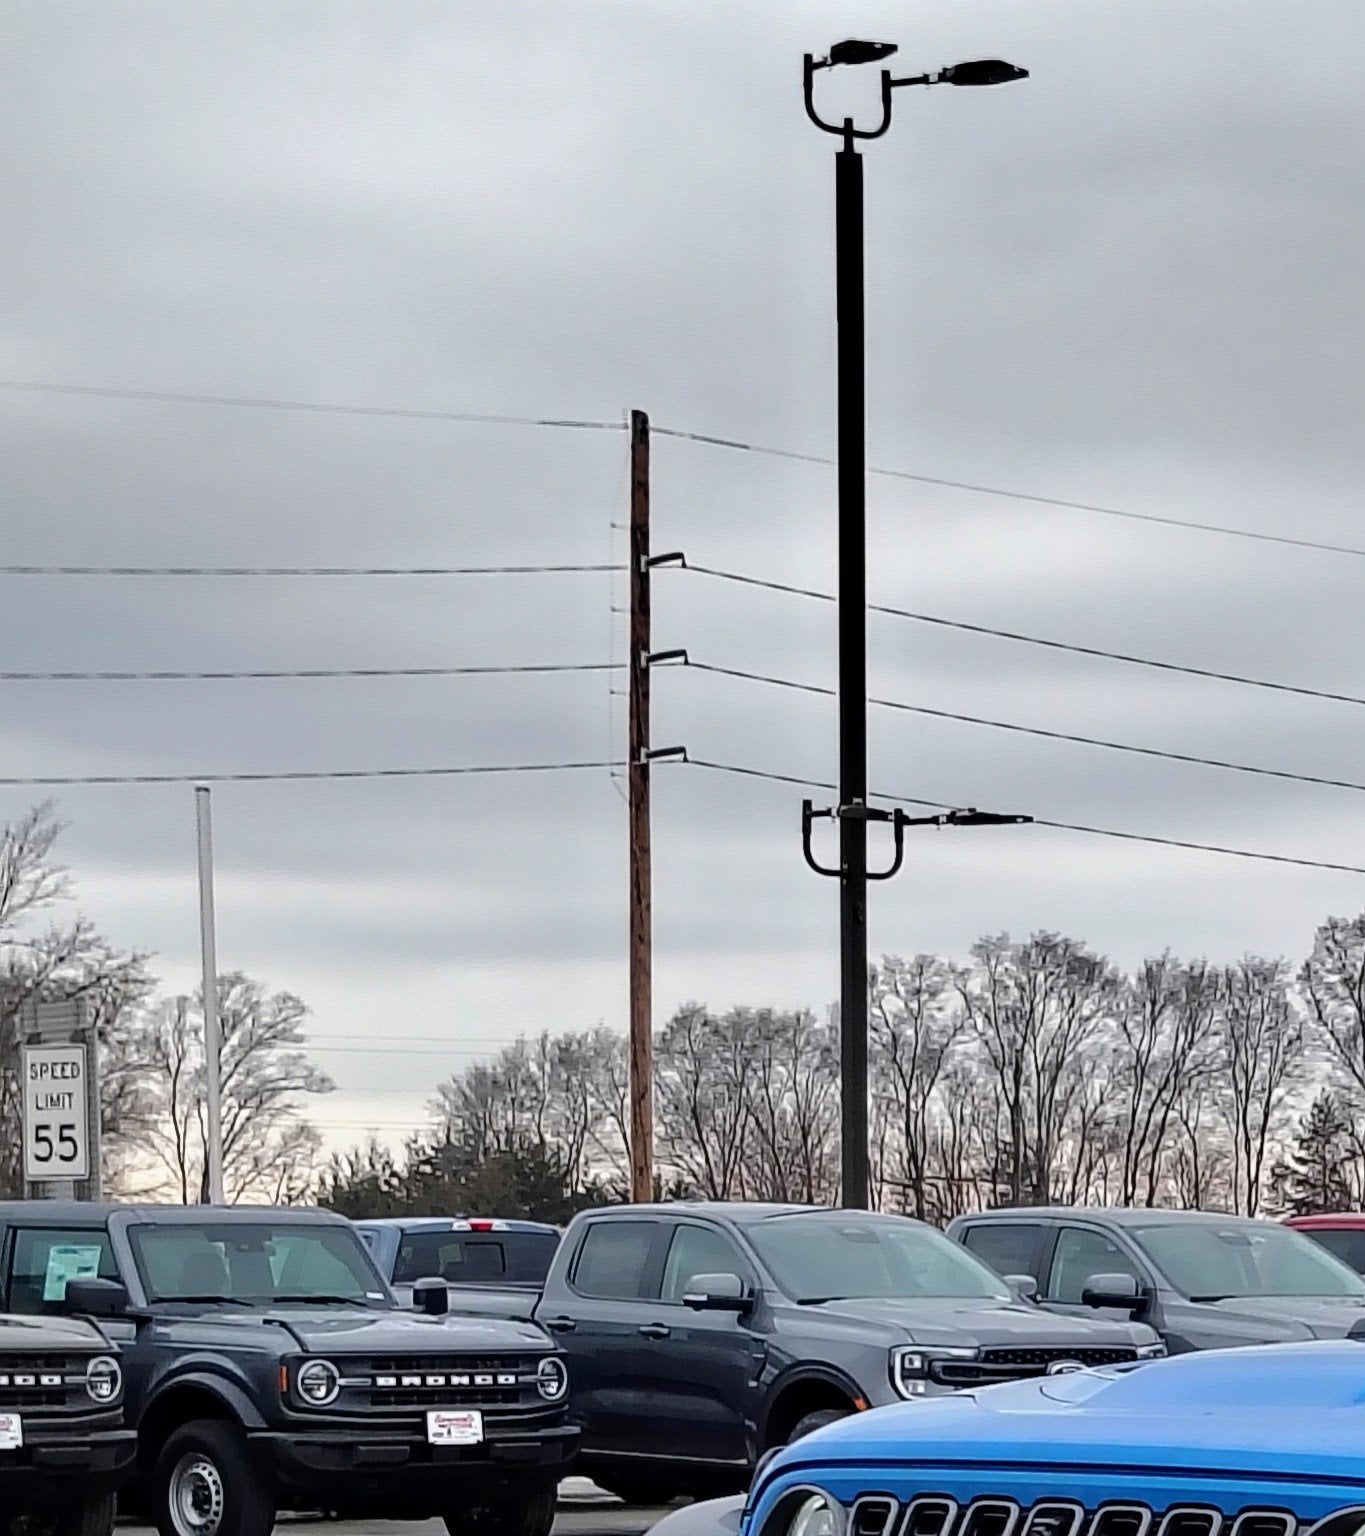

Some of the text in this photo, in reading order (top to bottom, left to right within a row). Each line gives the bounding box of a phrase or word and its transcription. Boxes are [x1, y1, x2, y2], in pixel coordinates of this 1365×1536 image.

[30, 1061, 80, 1080] SPEED
[35, 1091, 74, 1110] LIMIT
[34, 1123, 78, 1162] 55
